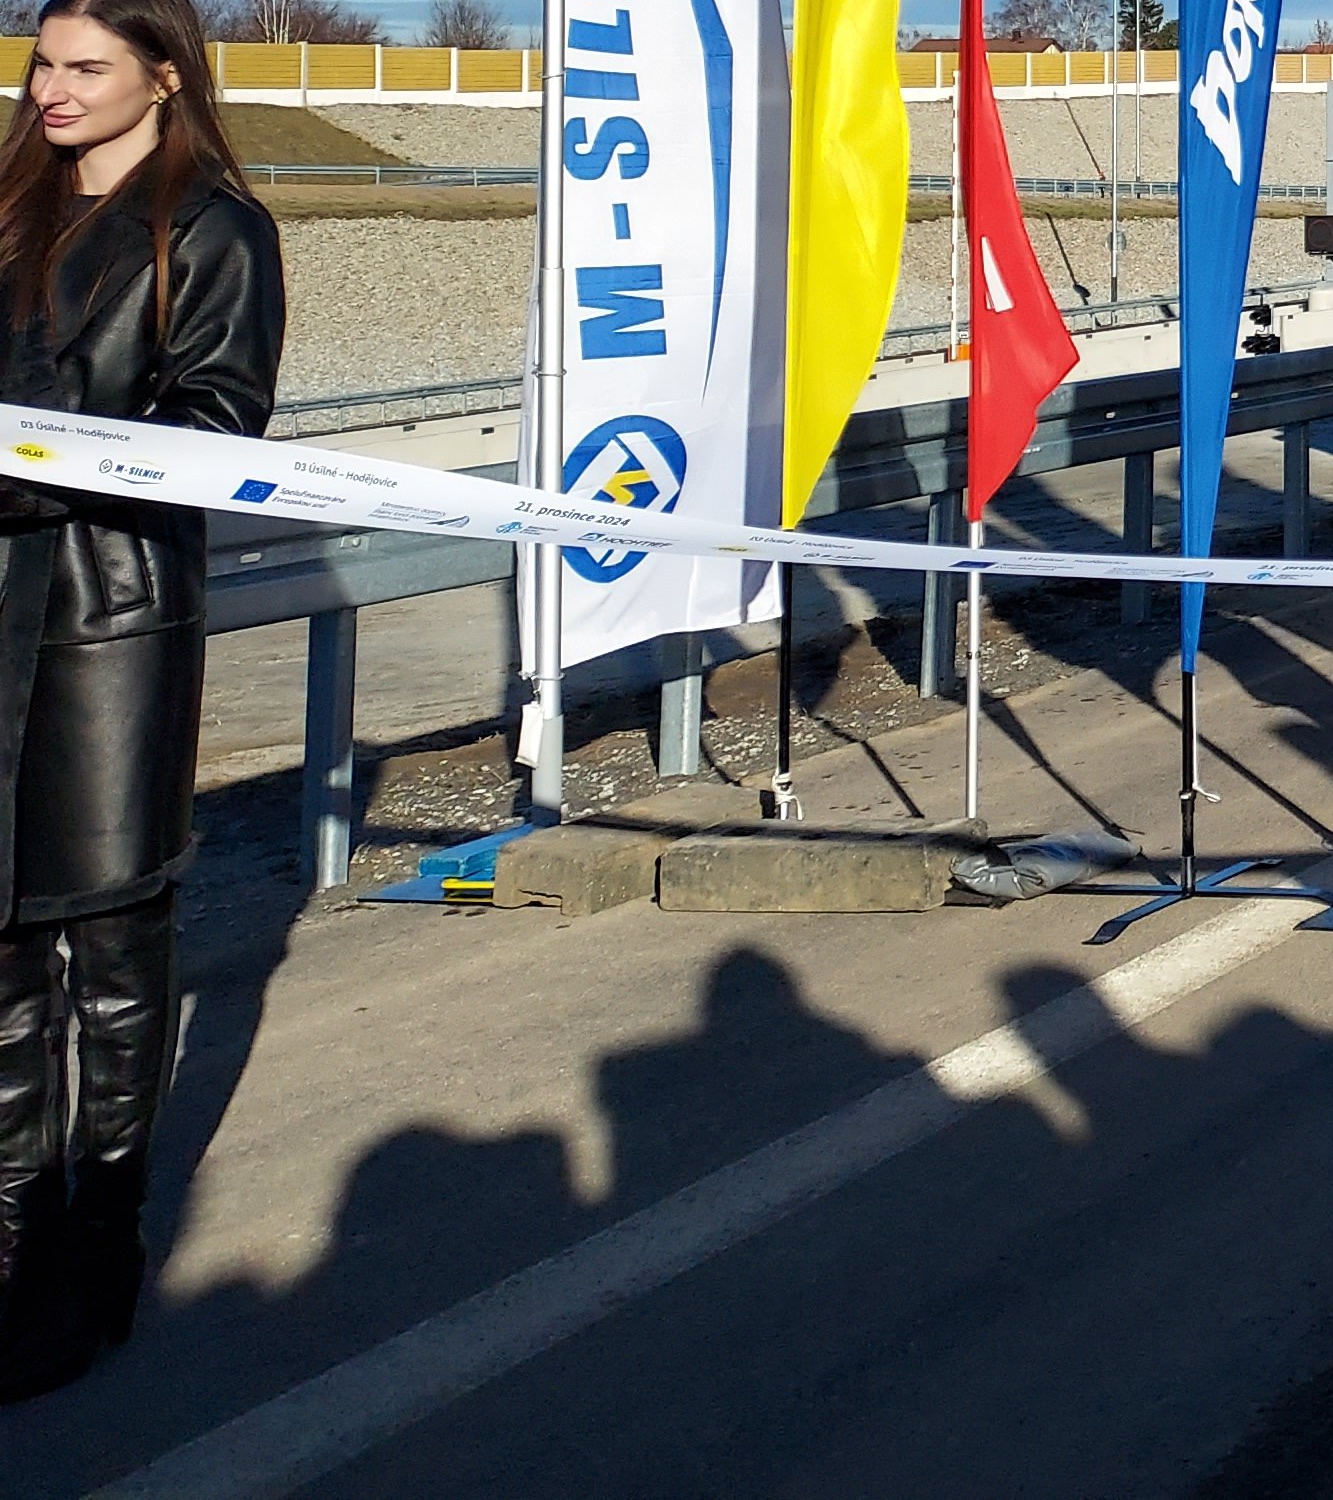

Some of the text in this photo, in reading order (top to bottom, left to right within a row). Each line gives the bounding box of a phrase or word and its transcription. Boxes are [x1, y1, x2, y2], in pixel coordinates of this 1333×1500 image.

[20, 420, 34, 430] D3
[36, 420, 67, 433] Úsilné
[77, 427, 131, 442] Hodějovice
[16, 446, 44, 458] COLAS
[294, 461, 307, 472] D3
[309, 461, 338, 477] Úsilné
[346, 472, 398, 489] Hodějovice
[514, 501, 632, 527] 21. prosince 2024
